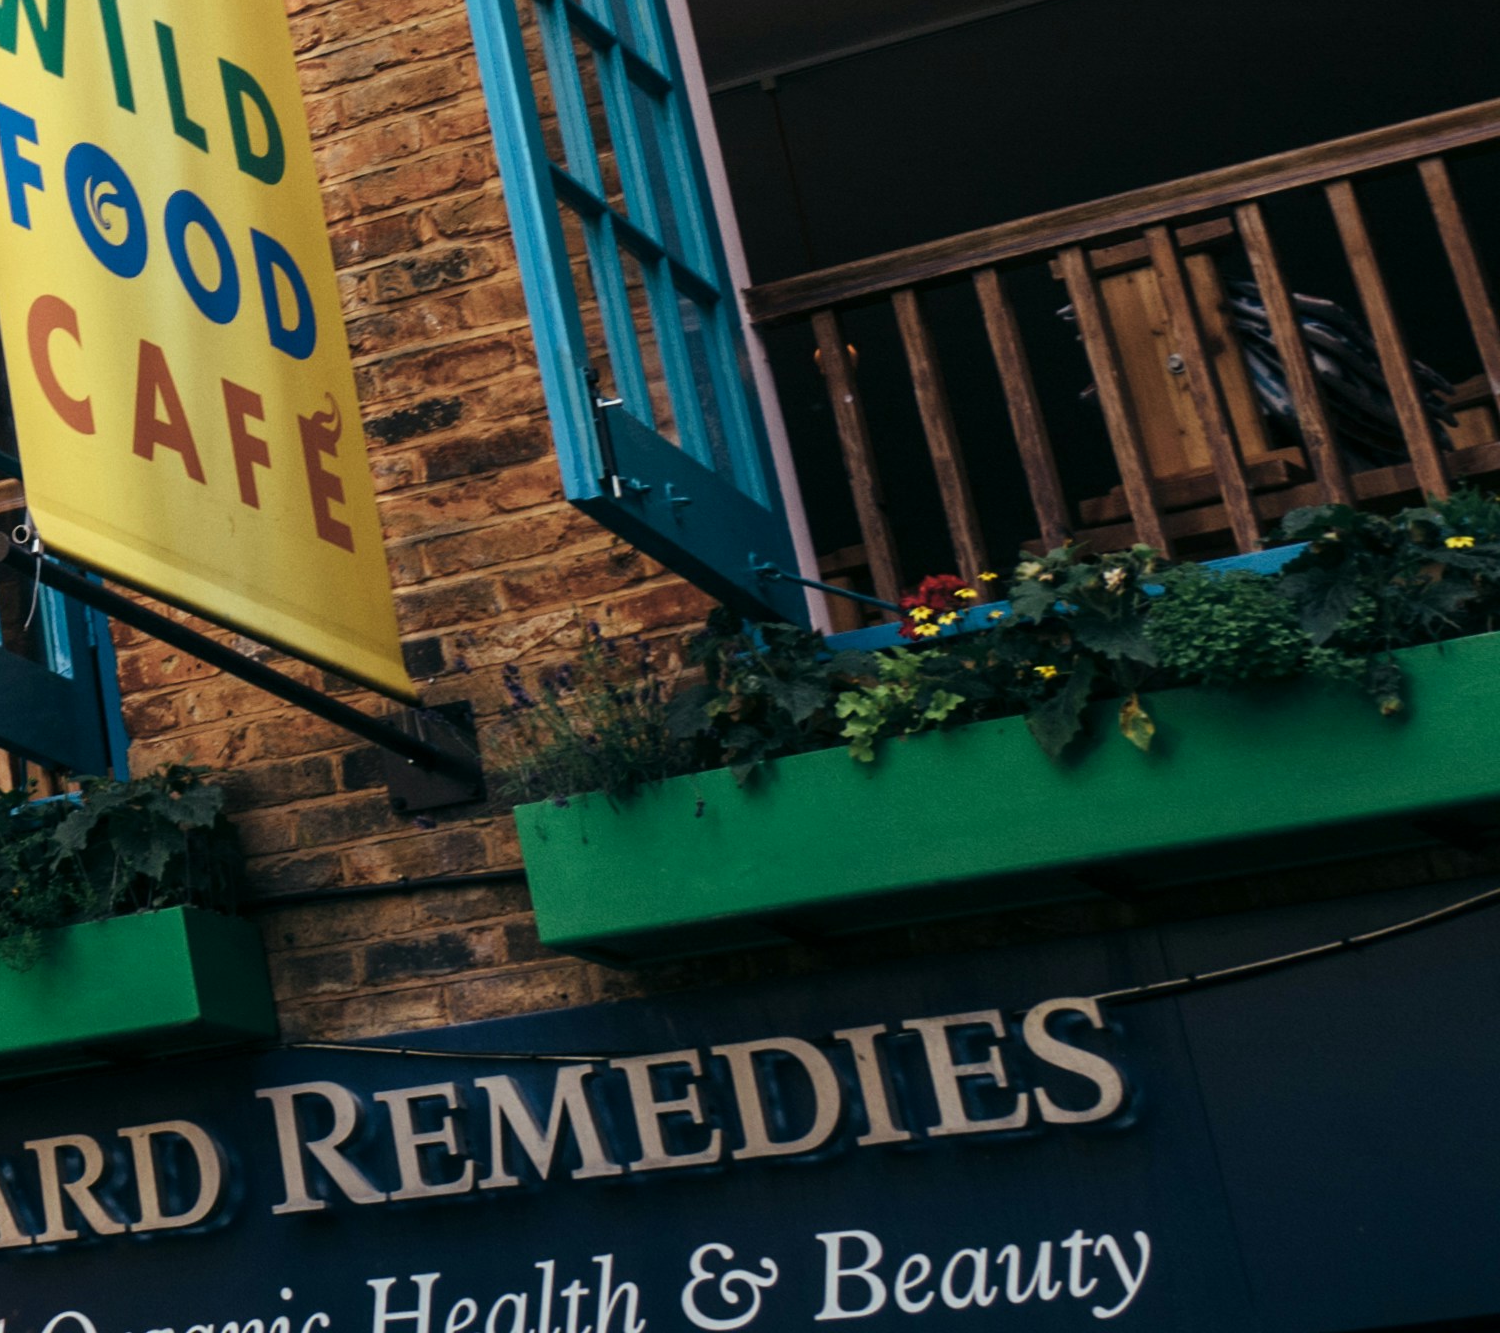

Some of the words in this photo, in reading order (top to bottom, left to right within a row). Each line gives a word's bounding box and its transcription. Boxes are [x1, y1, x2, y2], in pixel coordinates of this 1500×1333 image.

[257, 996, 1124, 1215] REMEDIES
[366, 1253, 647, 1333] Health
[681, 1242, 779, 1331] &
[814, 1228, 1152, 1321] Beauty
